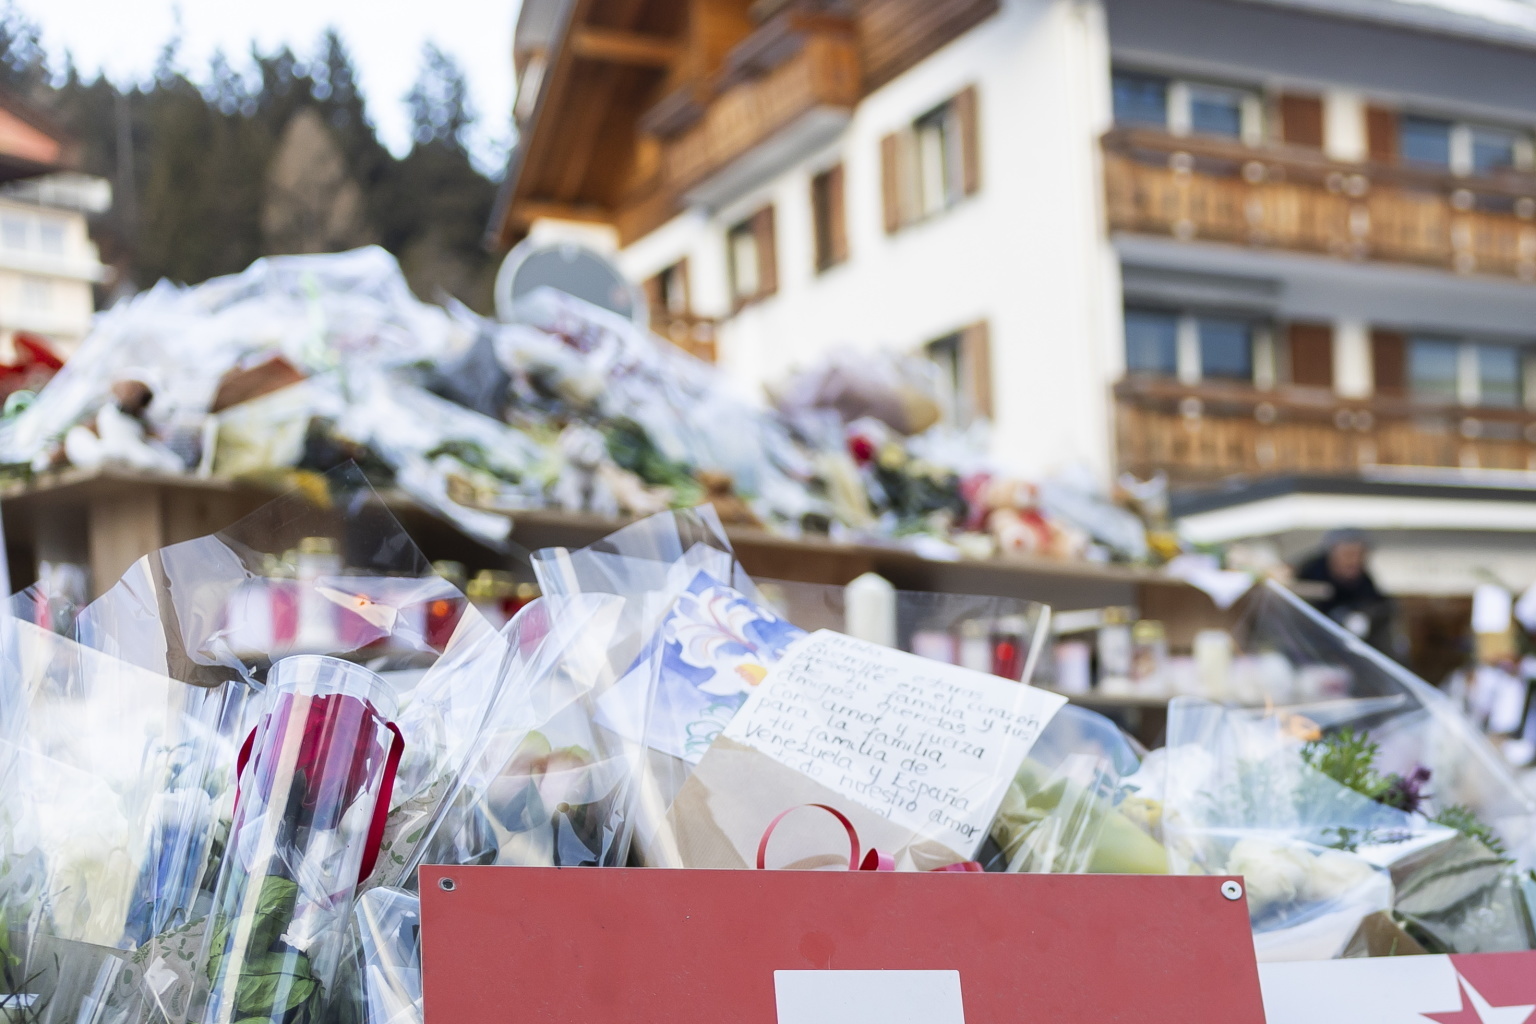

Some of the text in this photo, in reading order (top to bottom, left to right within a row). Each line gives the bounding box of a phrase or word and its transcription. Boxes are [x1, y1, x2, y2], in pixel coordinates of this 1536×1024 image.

[821, 701, 883, 725] amor
[826, 714, 848, 731] la
[744, 719, 853, 770] Venezuela
[866, 764, 882, 787] y
[890, 771, 971, 811] España
[899, 757, 929, 775] de
